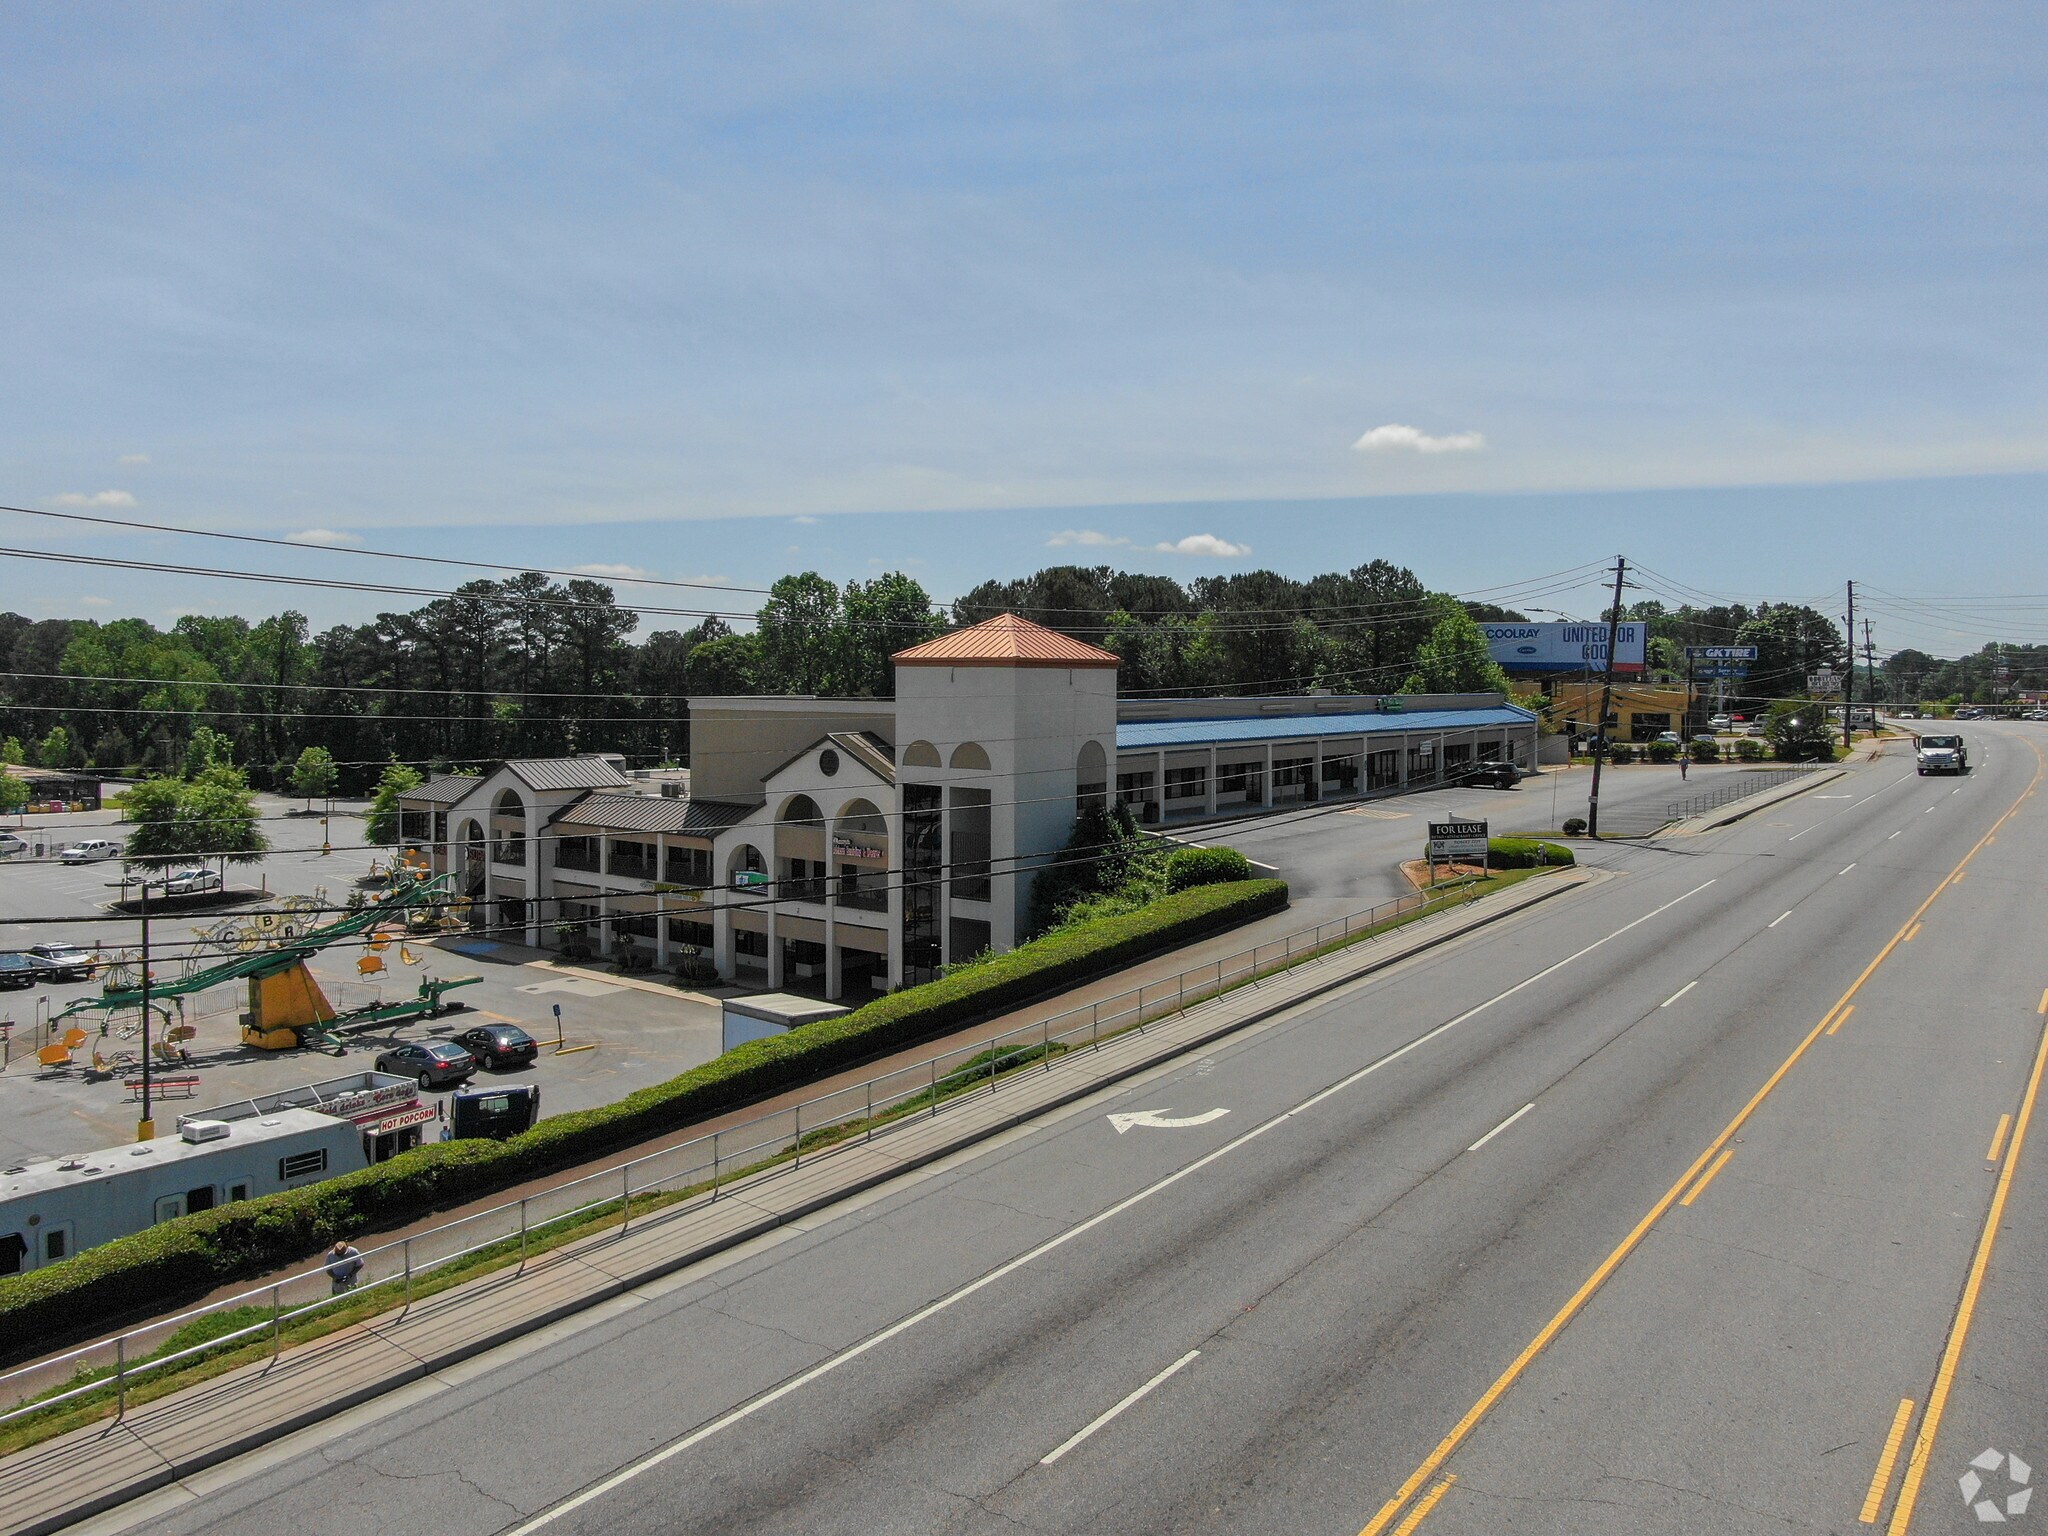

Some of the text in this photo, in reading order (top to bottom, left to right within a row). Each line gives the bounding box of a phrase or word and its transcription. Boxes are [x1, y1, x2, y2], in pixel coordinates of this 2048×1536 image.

[1486, 629, 1540, 638] COOLRAY
[1563, 627, 1635, 642] UNITED OR
[1582, 644, 1609, 659] GOO
[1724, 649, 1751, 657] TIRE
[1436, 825, 1482, 834] FOR LEASE
[263, 916, 273, 927] B
[223, 931, 235, 943] C
[382, 1109, 434, 1130] HOT POPCORN
